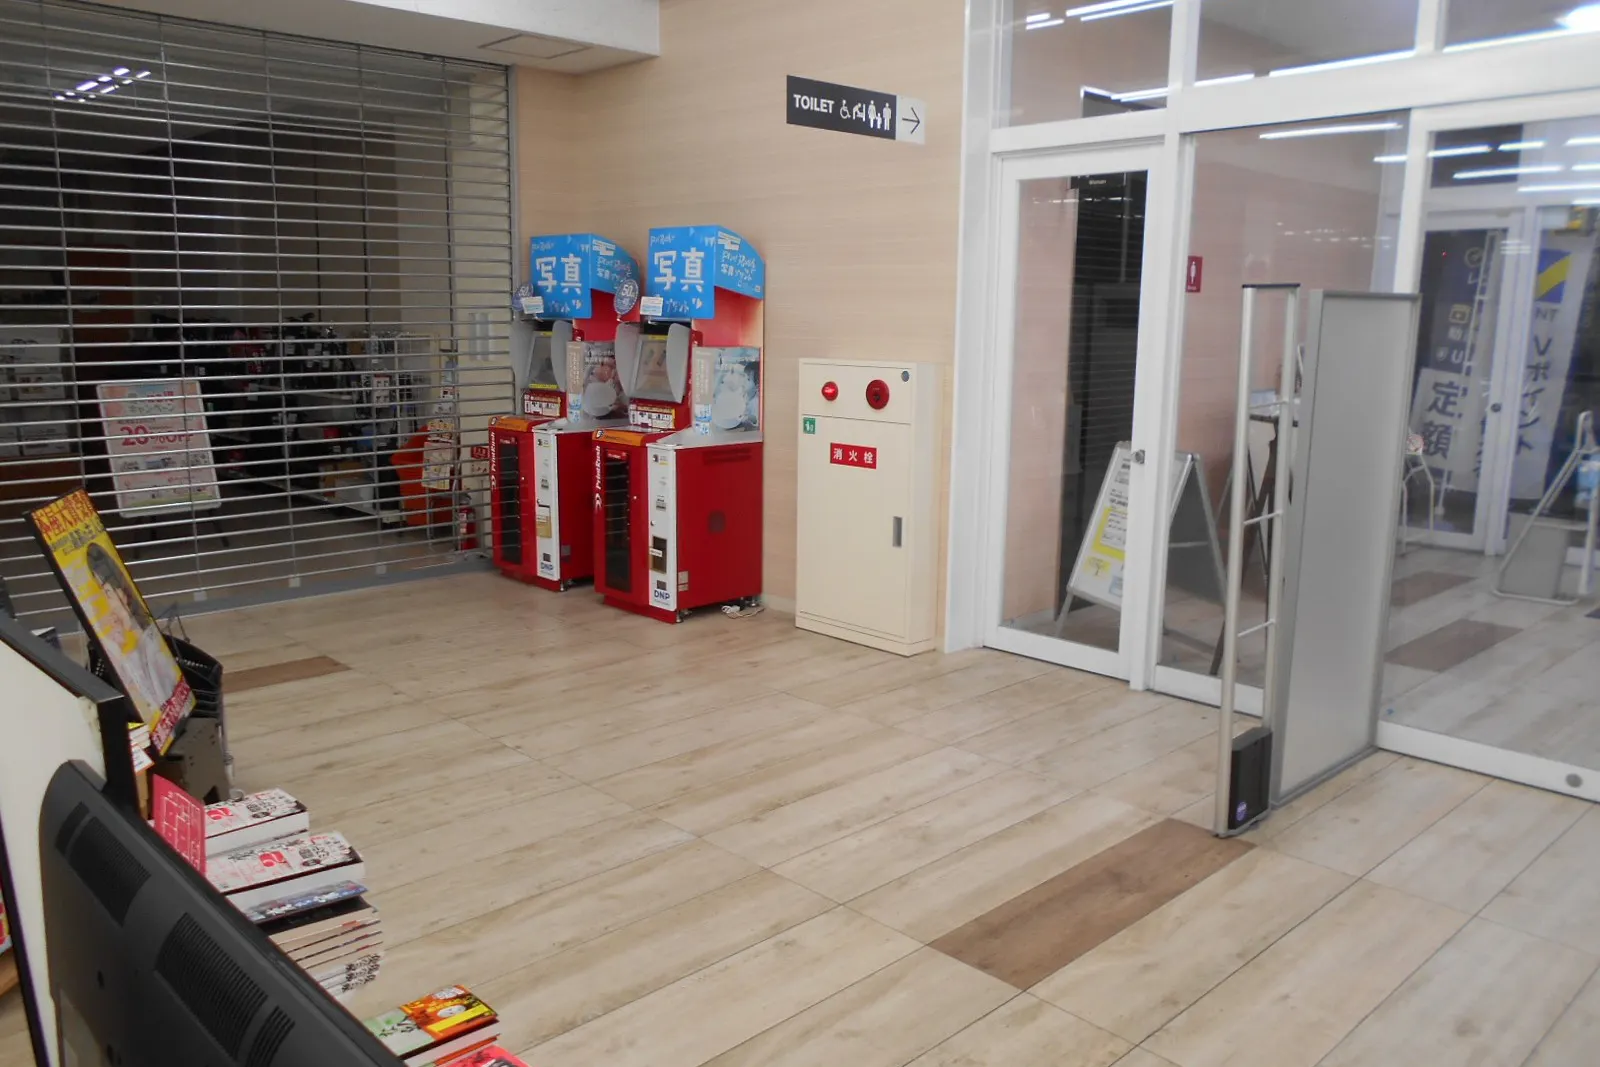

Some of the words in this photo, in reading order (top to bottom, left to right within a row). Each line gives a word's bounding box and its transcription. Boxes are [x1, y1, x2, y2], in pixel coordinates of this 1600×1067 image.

[793, 95, 834, 113] TOILET
[536, 253, 582, 295] 写真
[654, 247, 705, 293] 写真
[833, 448, 873, 464] 消火栓
[653, 589, 671, 600] DNP
